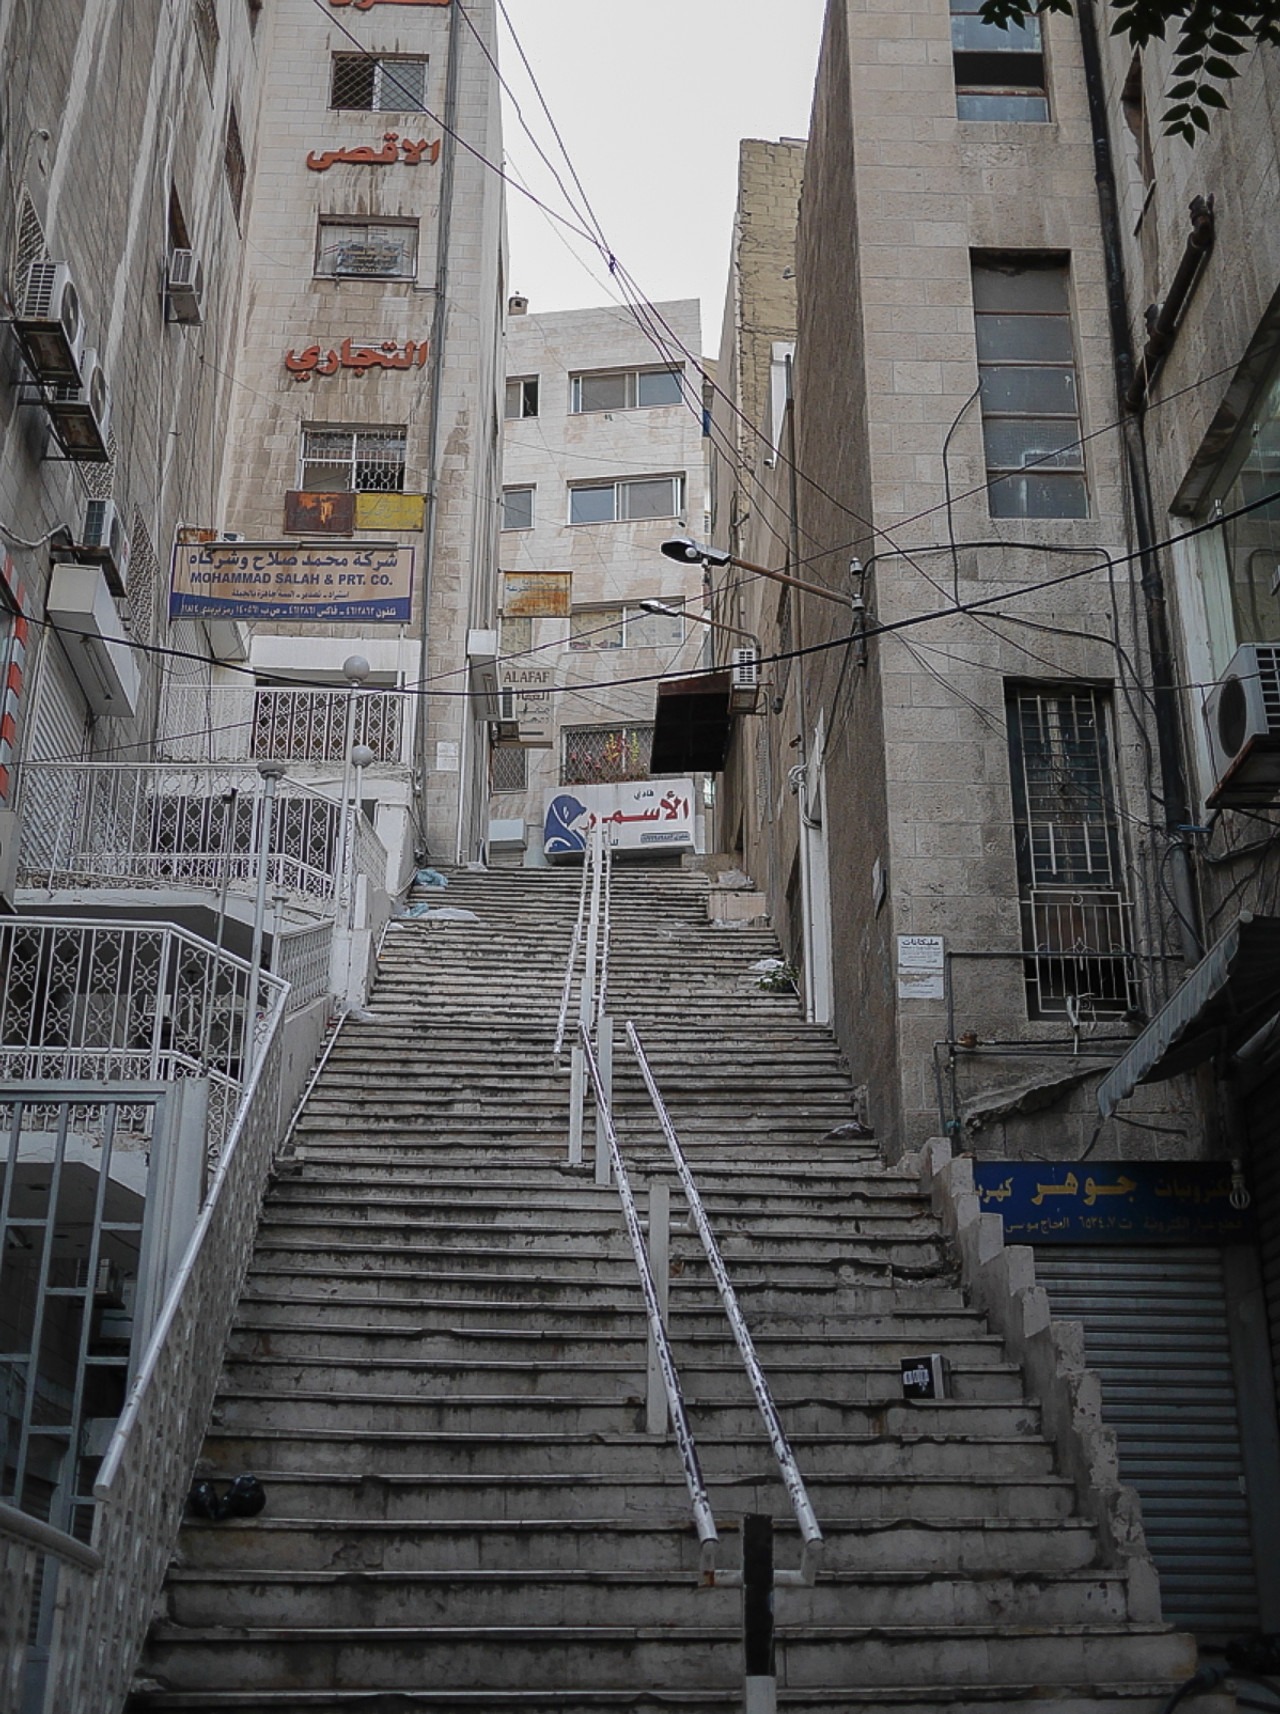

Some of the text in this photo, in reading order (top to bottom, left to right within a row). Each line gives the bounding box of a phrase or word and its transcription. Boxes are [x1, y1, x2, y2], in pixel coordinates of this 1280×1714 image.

[285, 337, 428, 382] التجاري
[189, 550, 398, 571] شركة محمد صلاح وشركاه
[190, 572, 393, 586] MOHAMMAD SALAH & PRT. CO.
[503, 670, 550, 683] ALAFAF
[578, 790, 690, 831] الأسمر
[1030, 1171, 1139, 1206] جوهر
